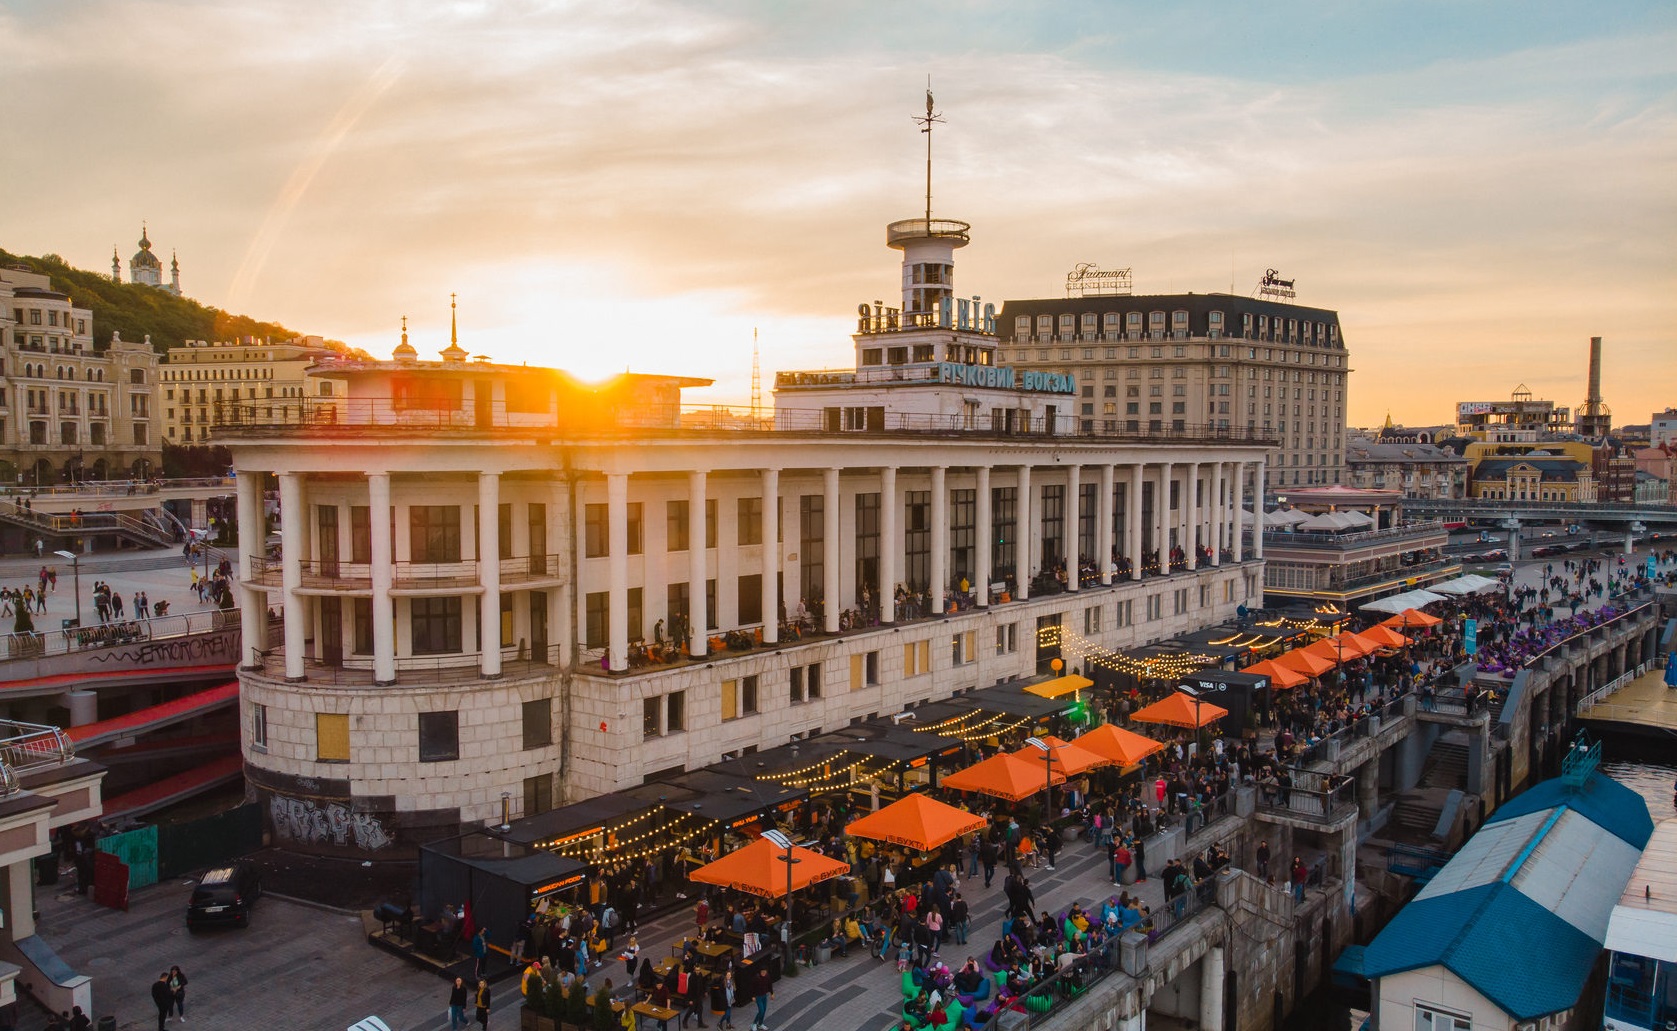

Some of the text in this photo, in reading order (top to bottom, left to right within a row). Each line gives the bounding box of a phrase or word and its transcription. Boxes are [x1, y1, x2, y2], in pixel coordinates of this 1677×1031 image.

[1067, 262, 1131, 282] Fairmont
[1023, 370, 1076, 393] ВОКЗАЛ
[1199, 681, 1214, 689] VISA
[896, 836, 925, 851] БУХТА
[565, 875, 581, 885] FOOD
[820, 865, 849, 881] БУХТА
[741, 883, 770, 898] БУХТА
